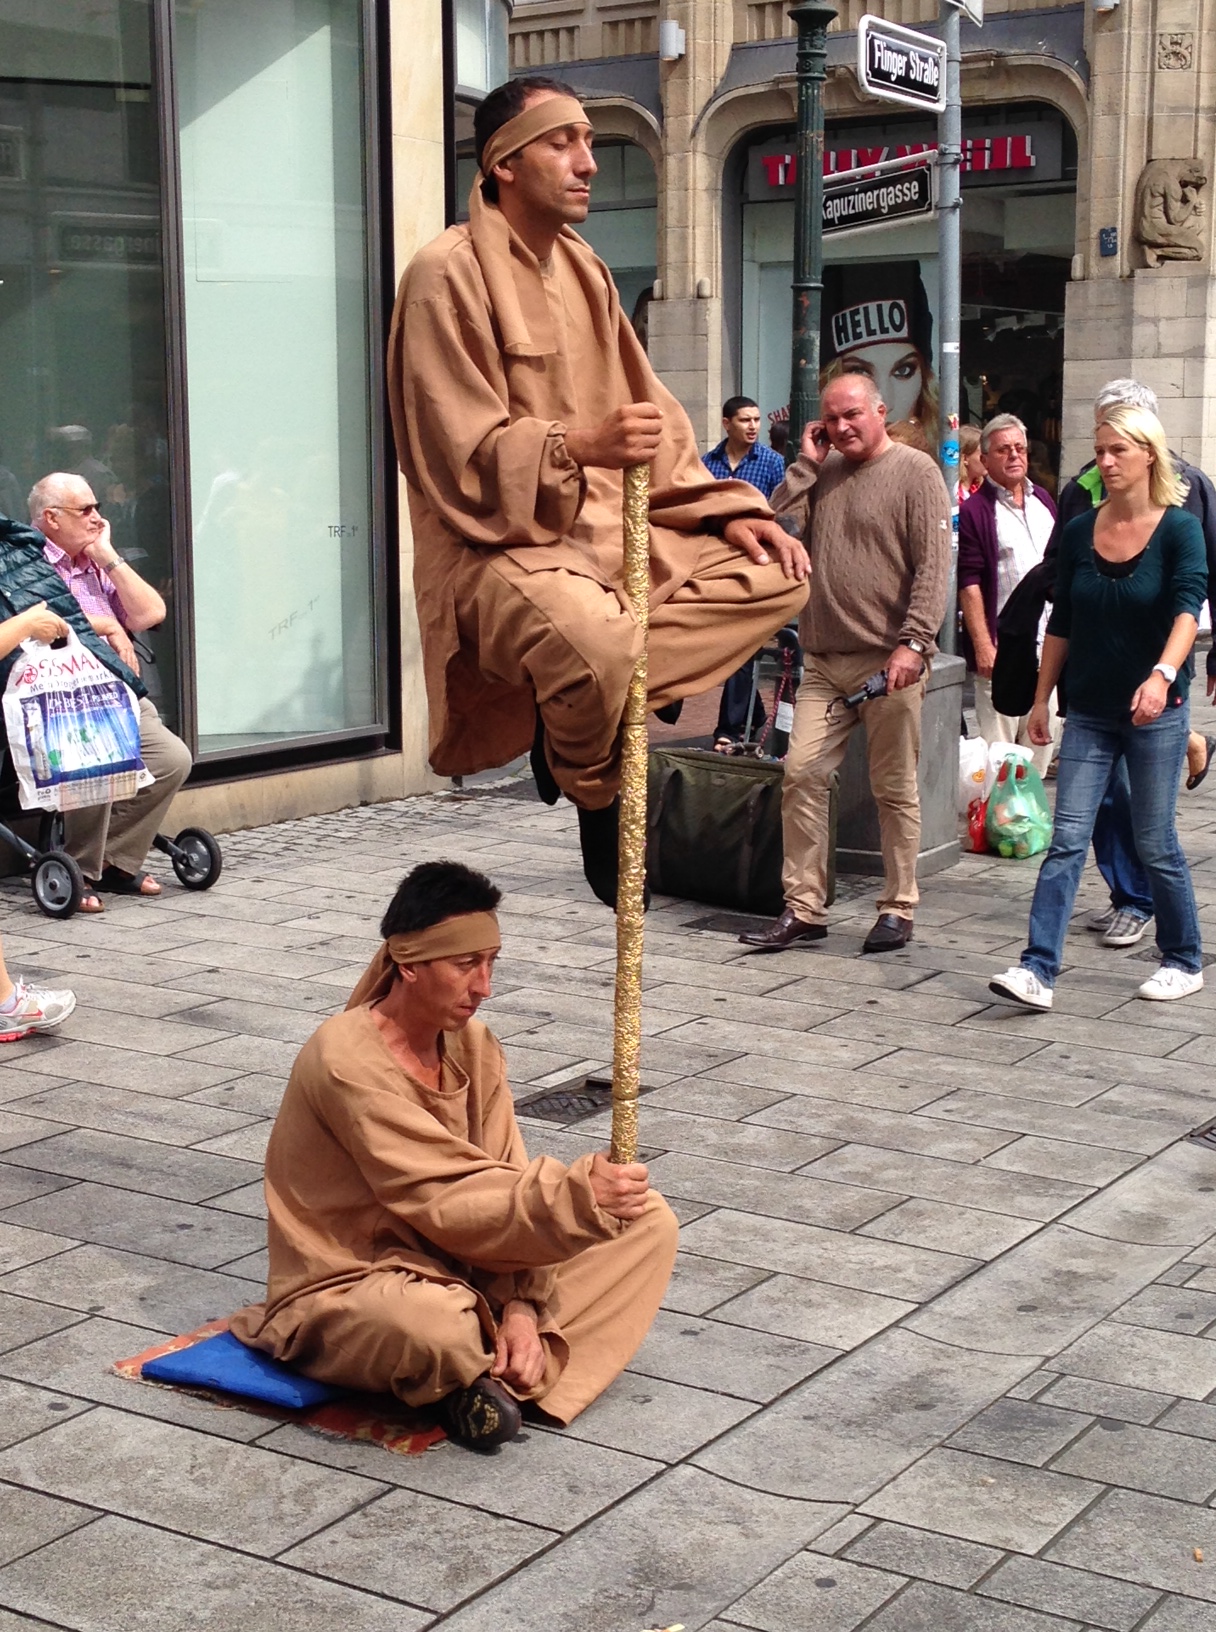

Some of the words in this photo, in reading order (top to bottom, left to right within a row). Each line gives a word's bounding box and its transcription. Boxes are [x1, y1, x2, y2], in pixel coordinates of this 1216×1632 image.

[874, 38, 907, 82] Flinger
[909, 50, 939, 87] Straße
[834, 301, 906, 346] HELLO
